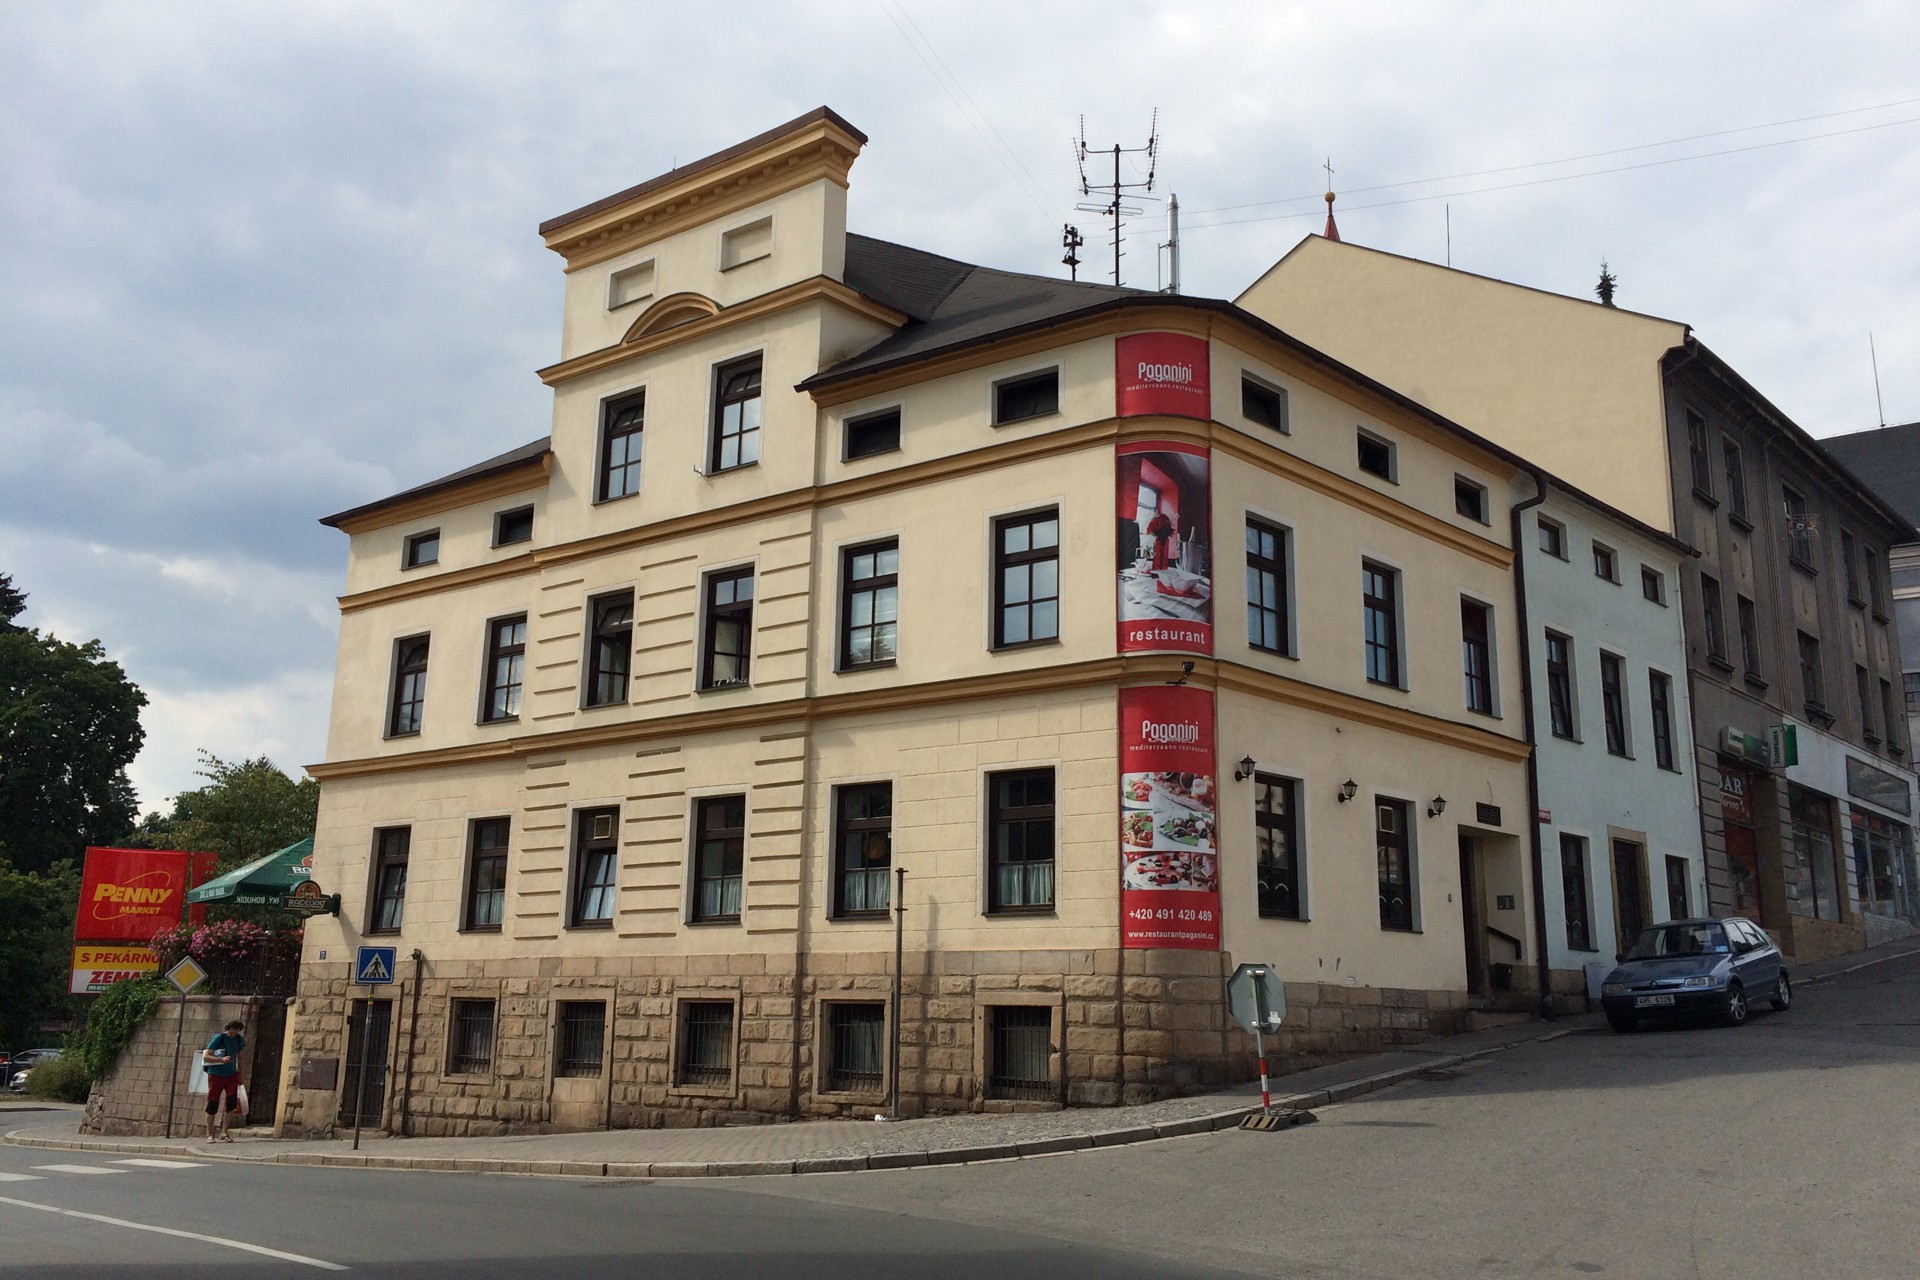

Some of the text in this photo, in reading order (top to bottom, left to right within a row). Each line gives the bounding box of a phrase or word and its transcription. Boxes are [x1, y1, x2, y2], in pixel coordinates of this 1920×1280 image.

[1138, 362, 1192, 382] Paganini
[1172, 384, 1203, 395] restaurant
[1129, 627, 1205, 644] restaurant
[1142, 720, 1198, 743] Paganini
[1179, 745, 1209, 754] restaurant
[288, 898, 327, 909] RADEGAST
[119, 905, 161, 915] MARKET
[1129, 908, 1212, 922] +420 491 420 489
[1128, 930, 1214, 940] www.restaurantpaganini.cz
[80, 952, 91, 963] S
